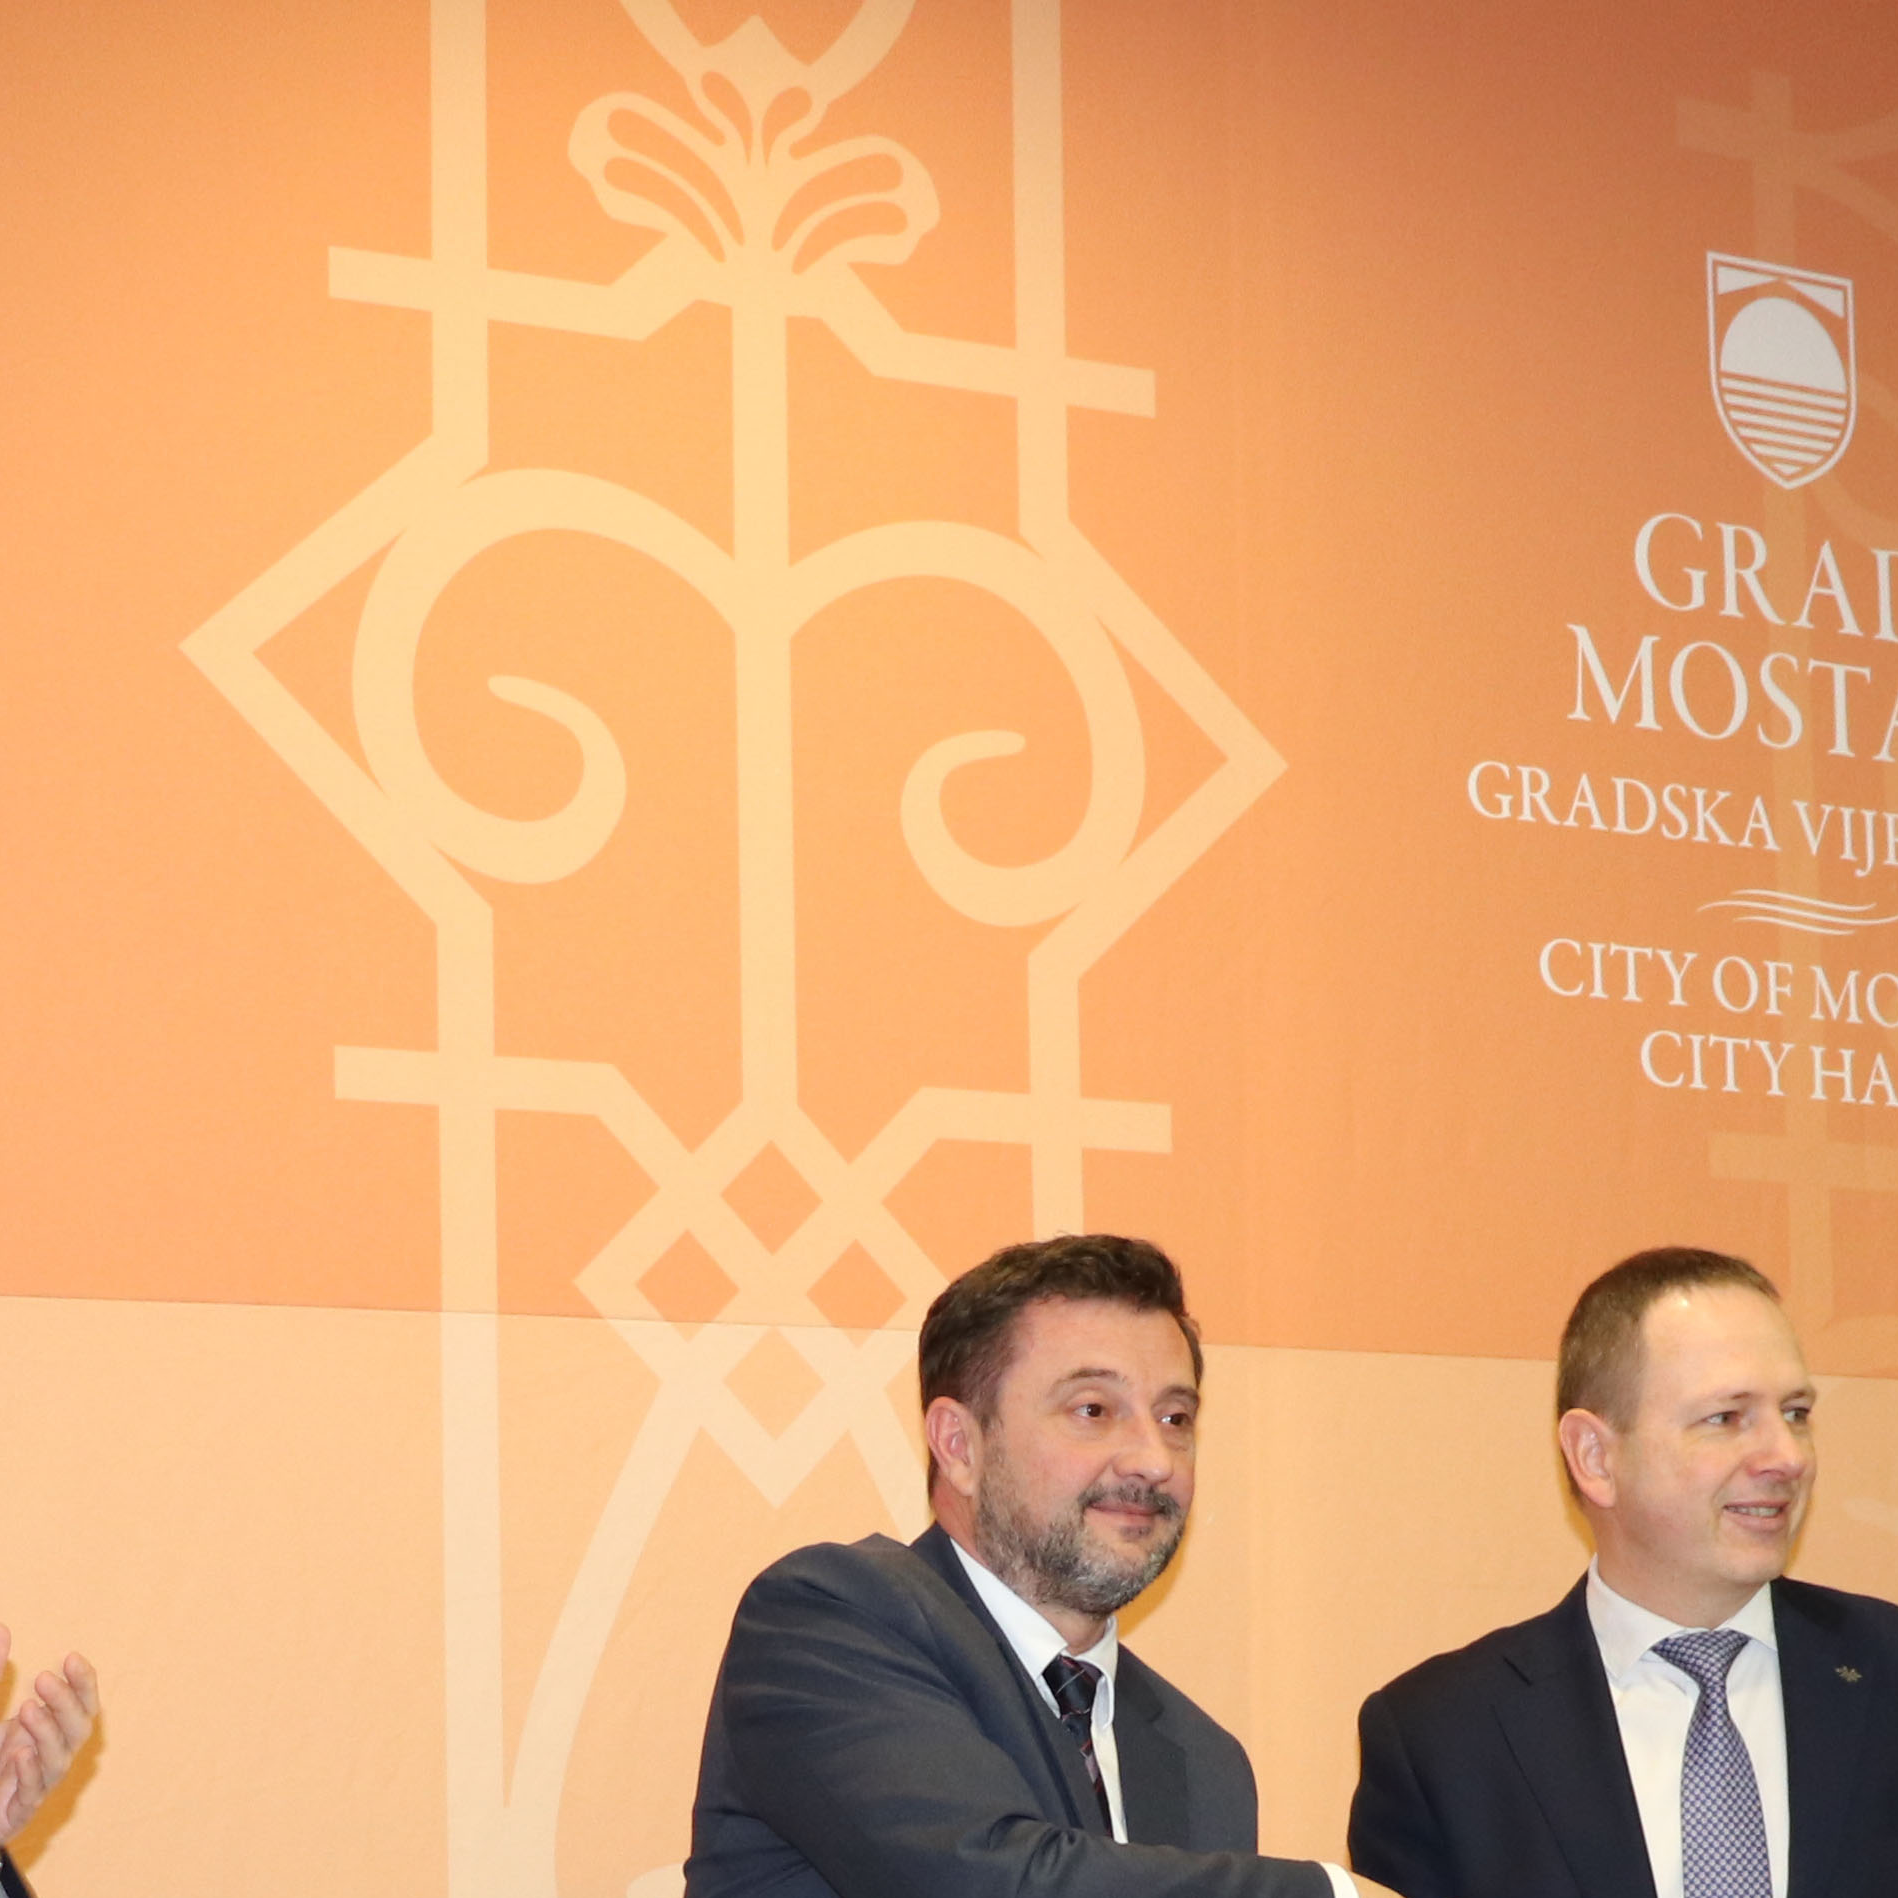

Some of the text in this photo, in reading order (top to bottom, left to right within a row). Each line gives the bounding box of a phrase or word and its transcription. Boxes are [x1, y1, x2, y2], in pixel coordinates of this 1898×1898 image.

[1466, 761, 1782, 852] GRADSKA
[1539, 938, 1697, 1006] CITY
[1712, 956, 1793, 1016] OF
[1640, 1030, 1794, 1097] CITY
